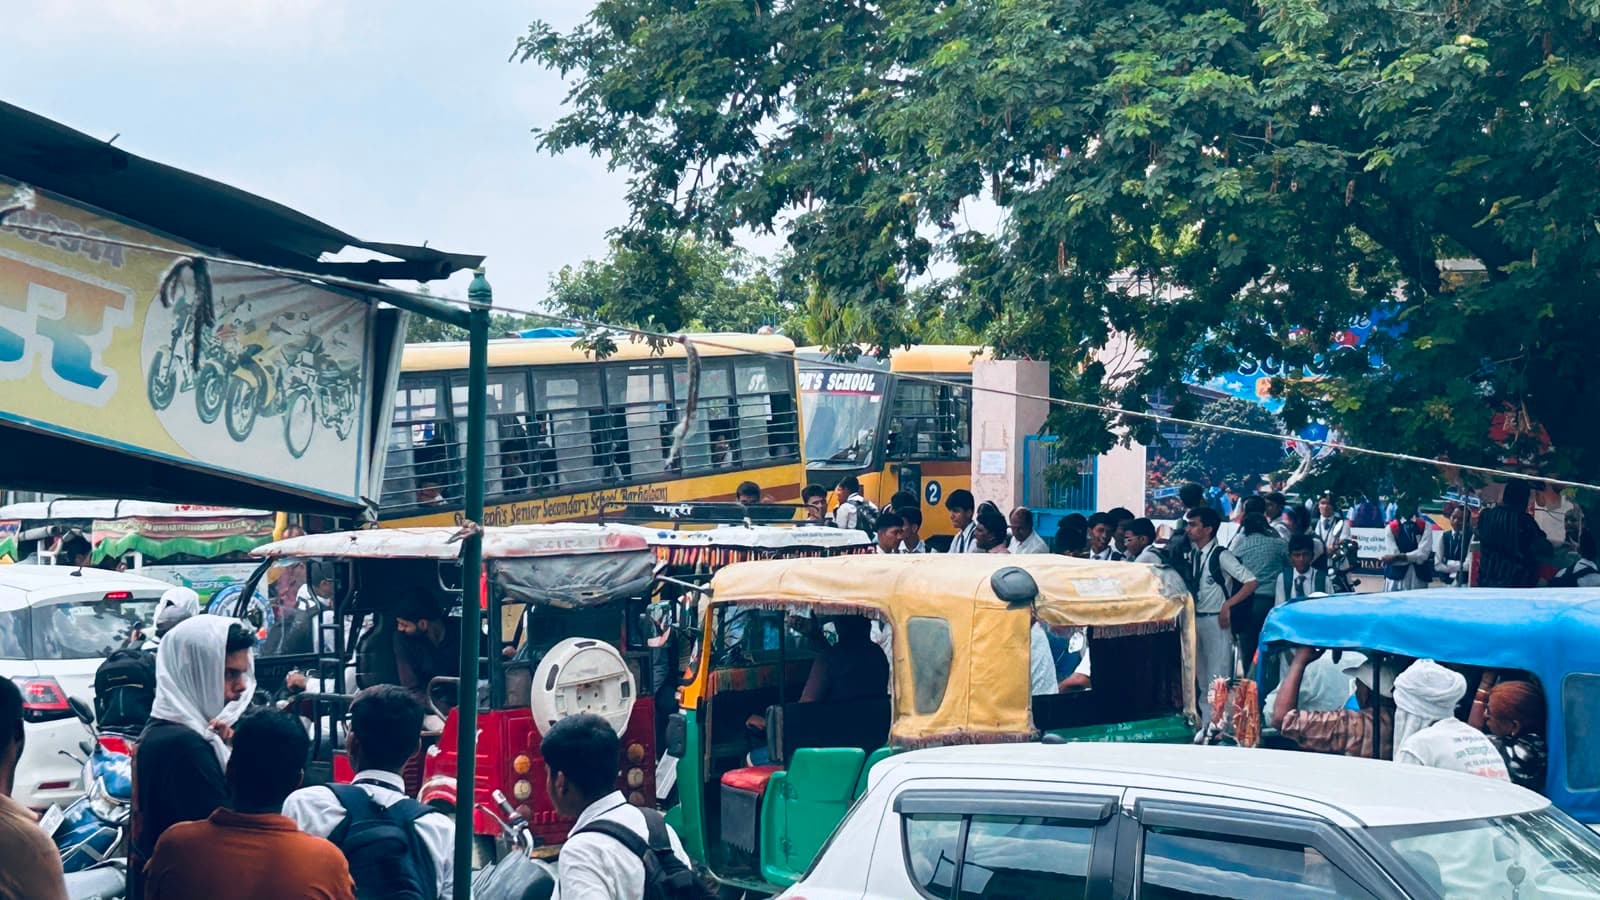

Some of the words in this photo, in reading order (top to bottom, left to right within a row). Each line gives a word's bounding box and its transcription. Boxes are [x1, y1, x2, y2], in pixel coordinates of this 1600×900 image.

[748, 373, 768, 391] ST.
[827, 372, 876, 391] SCHOOL
[928, 484, 938, 502] 2
[510, 501, 541, 522] Senior
[543, 494, 590, 517] Secondary
[590, 487, 618, 510] School
